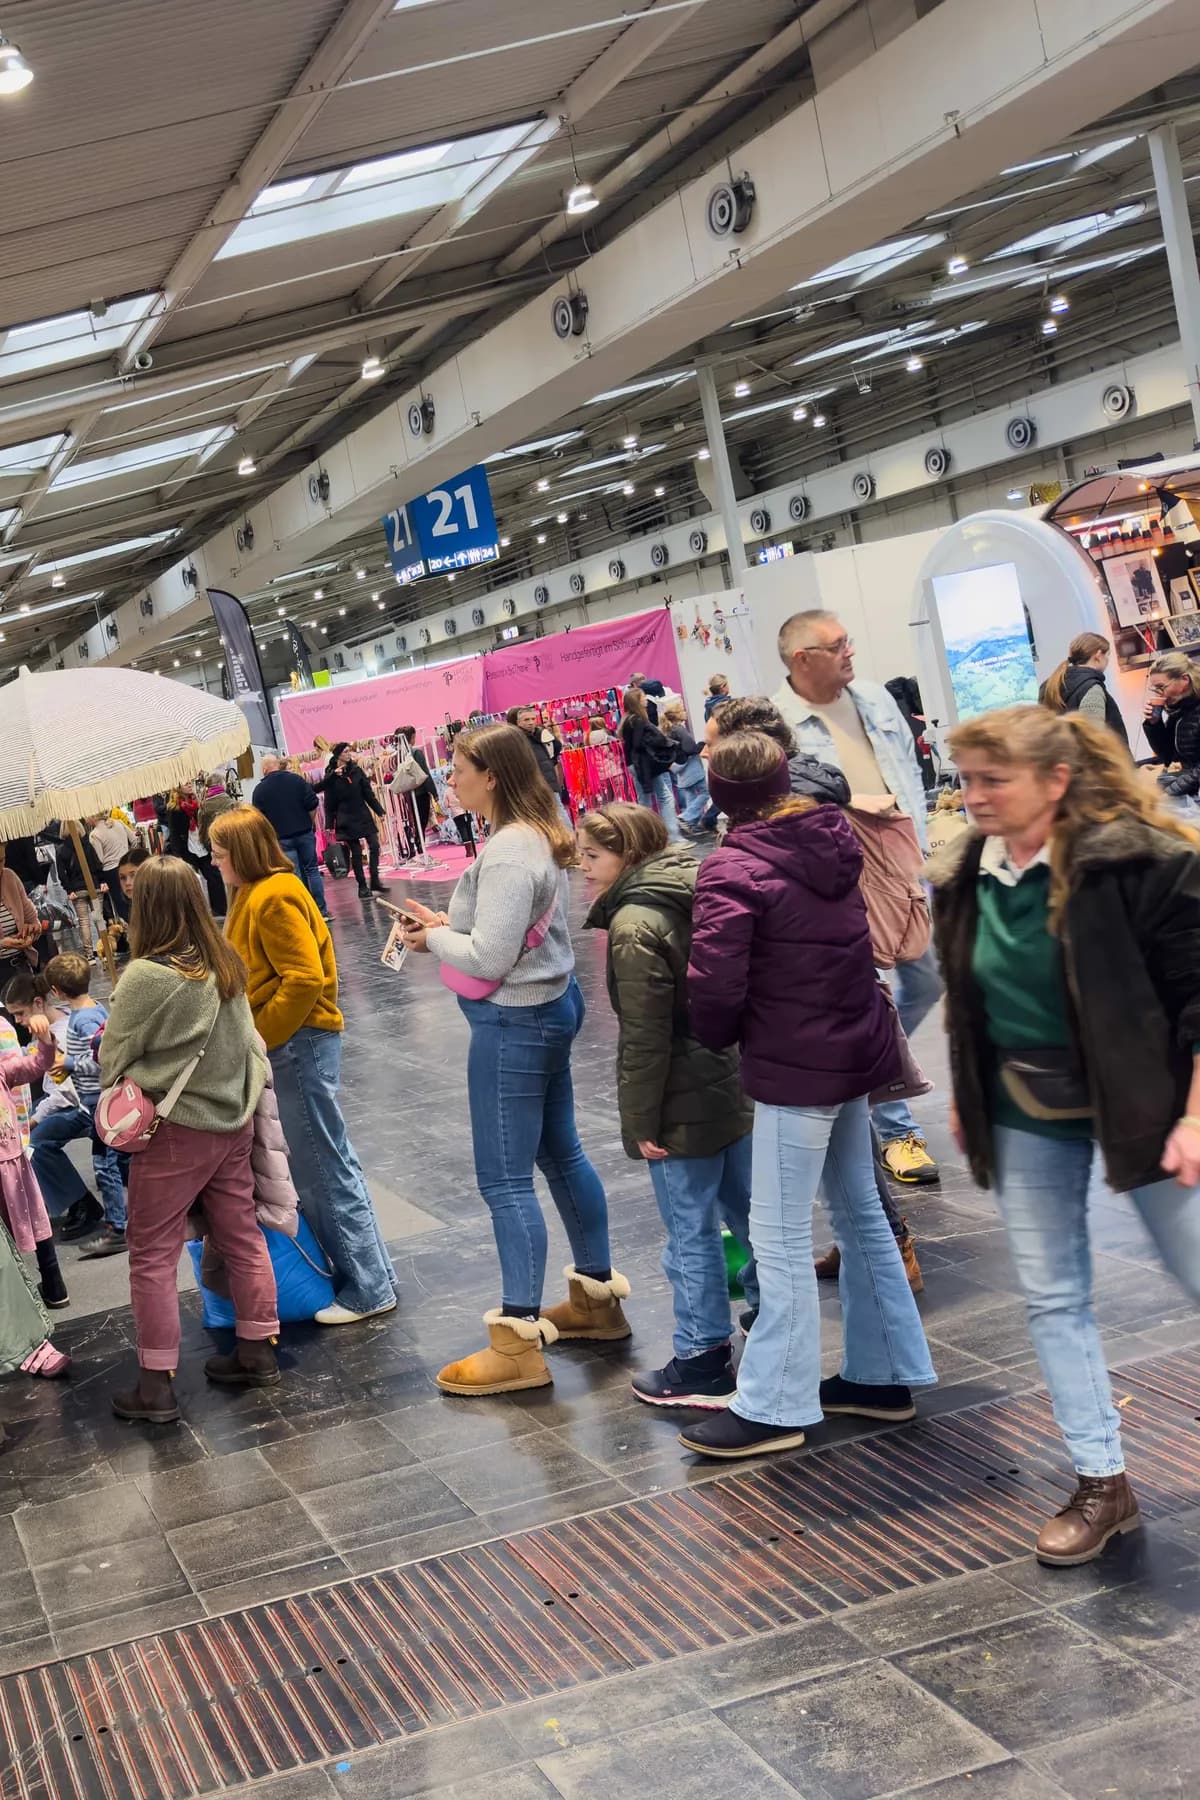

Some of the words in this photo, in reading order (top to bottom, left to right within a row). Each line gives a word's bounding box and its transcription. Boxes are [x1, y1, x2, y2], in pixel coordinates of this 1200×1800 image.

[387, 505, 412, 552] 21
[425, 484, 479, 537] 21
[430, 559, 442, 569] 20
